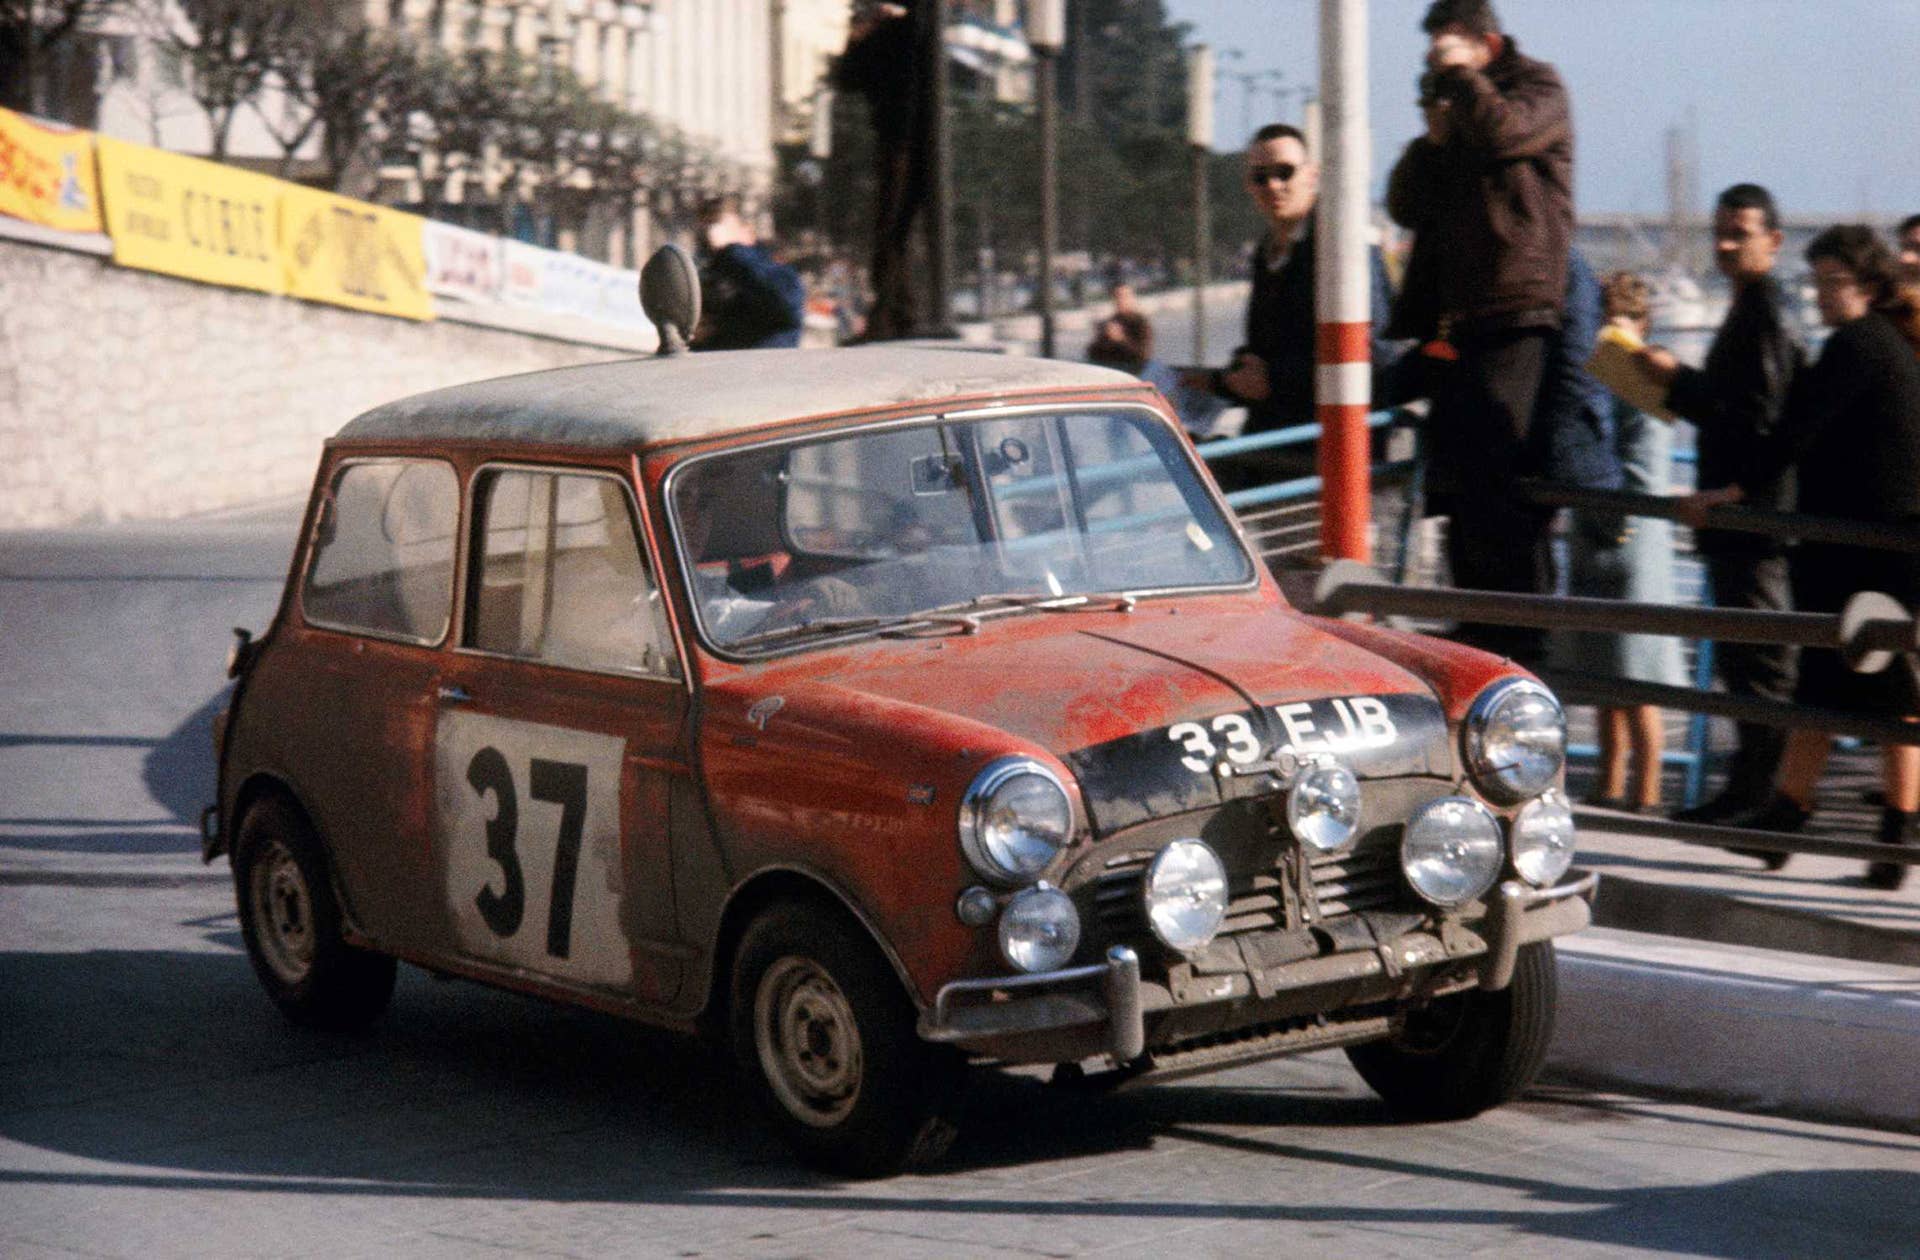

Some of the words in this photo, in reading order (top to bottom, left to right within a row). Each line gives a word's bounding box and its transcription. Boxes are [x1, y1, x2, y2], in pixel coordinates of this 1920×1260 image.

[1168, 713, 1261, 773] 33
[1275, 697, 1398, 753] EJB
[467, 746, 588, 959] 37
